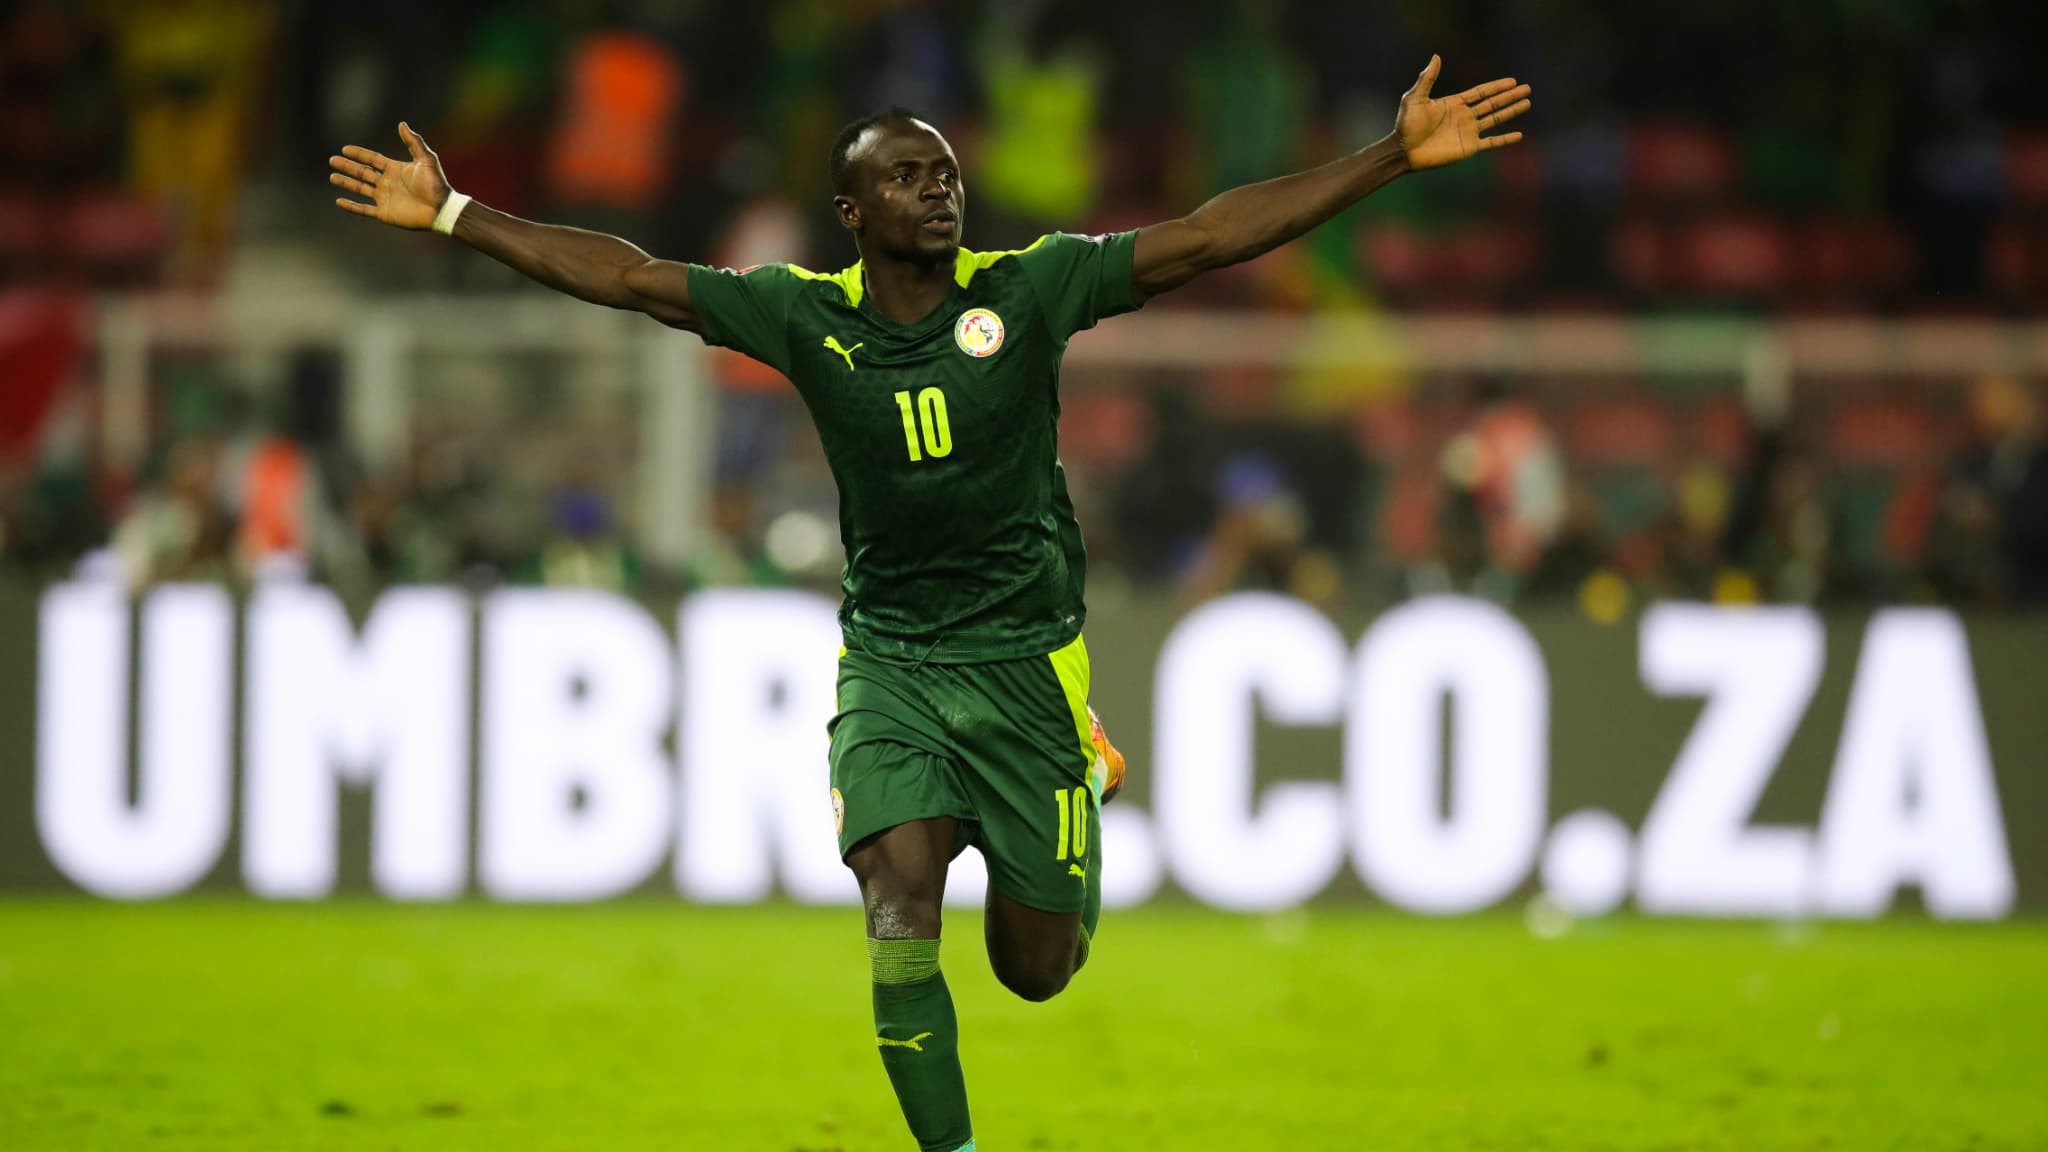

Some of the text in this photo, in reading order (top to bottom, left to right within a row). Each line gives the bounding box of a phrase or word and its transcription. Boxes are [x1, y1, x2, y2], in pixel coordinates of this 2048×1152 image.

[895, 387, 952, 461] 10
[36, 583, 2014, 919] UMBR.CO.ZA
[1055, 786, 1088, 861] 10
